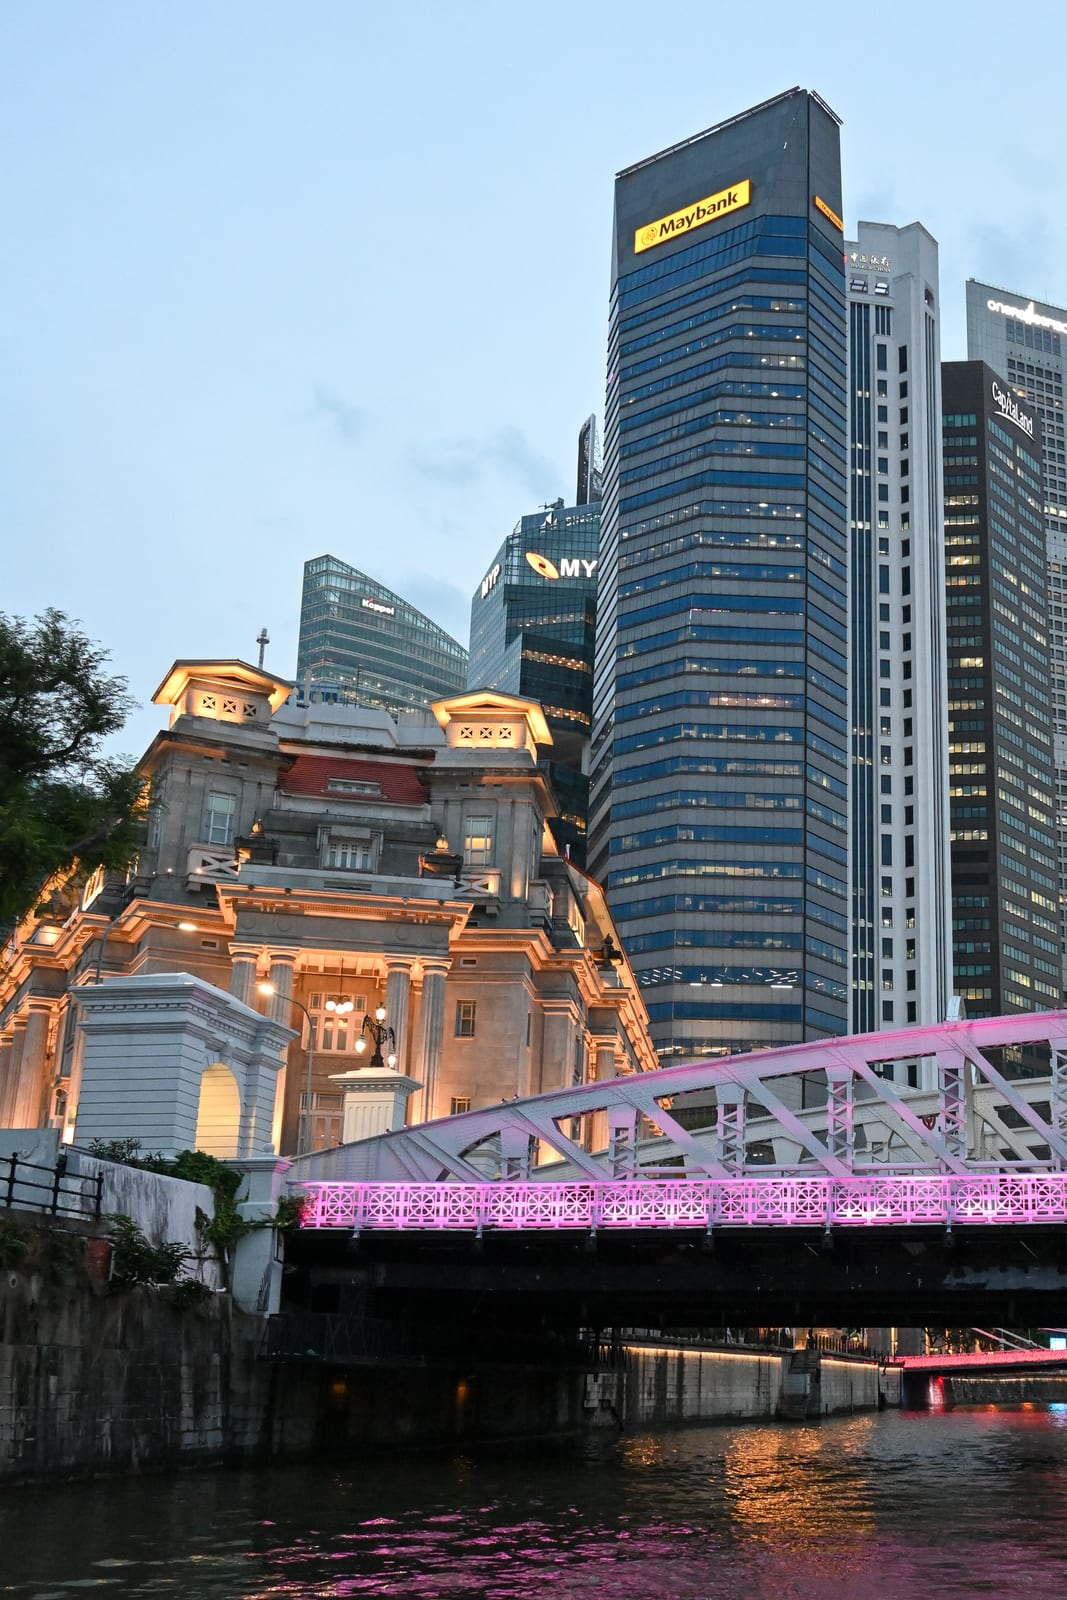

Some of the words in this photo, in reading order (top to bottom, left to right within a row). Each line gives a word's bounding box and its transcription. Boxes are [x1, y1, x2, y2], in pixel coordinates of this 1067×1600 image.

[658, 191, 739, 238] Maybank
[991, 381, 1033, 435] CapitaLand
[361, 597, 395, 616] Keppel
